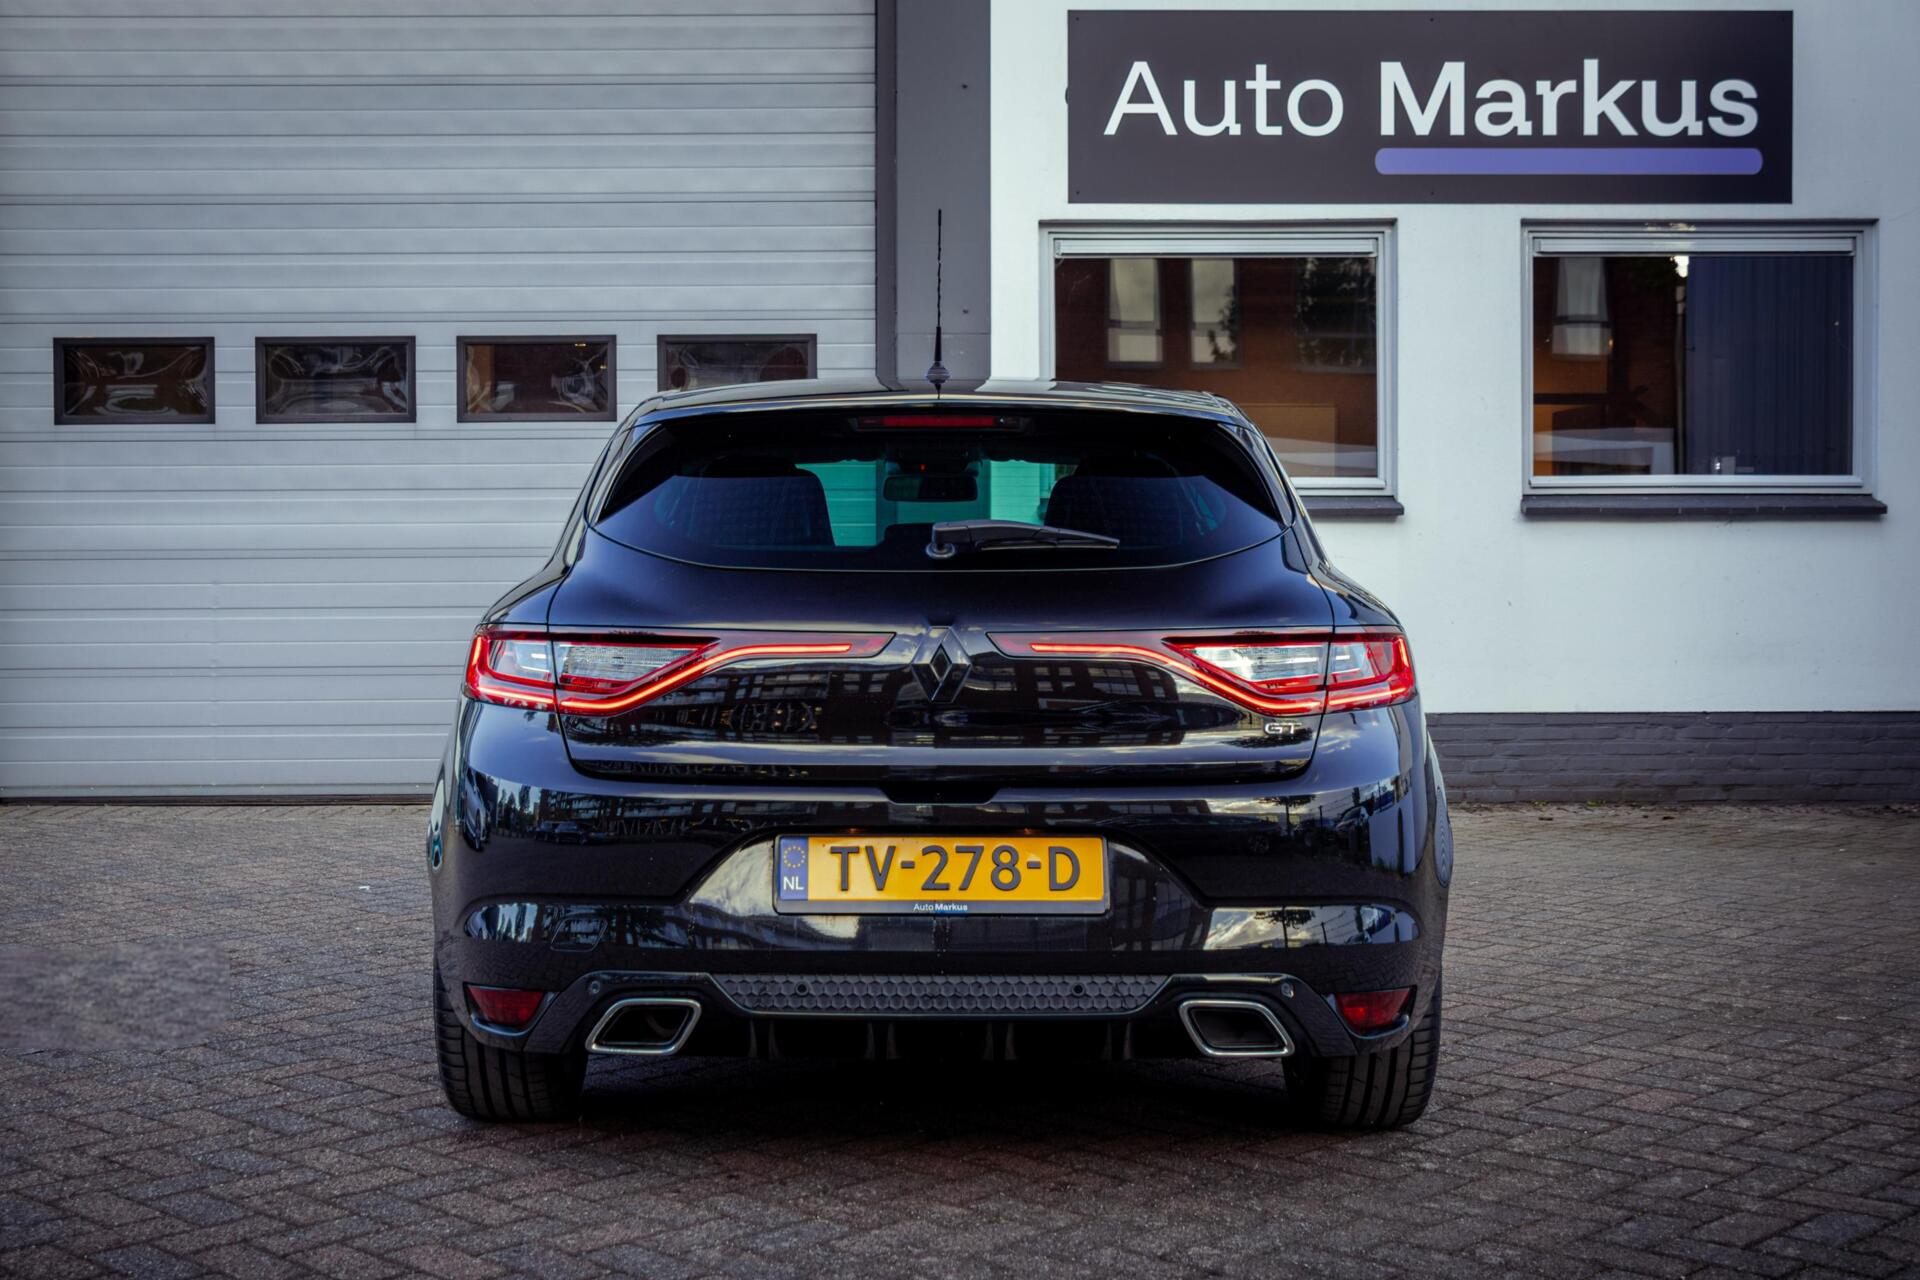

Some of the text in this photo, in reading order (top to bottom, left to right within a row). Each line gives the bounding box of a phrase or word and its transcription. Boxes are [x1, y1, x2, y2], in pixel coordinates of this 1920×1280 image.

[1104, 59, 1759, 137] Auto Markus
[1265, 722, 1302, 734] GT
[830, 845, 1081, 892] TV-278-D
[783, 876, 804, 890] NL
[913, 903, 968, 912] Auto Markus
